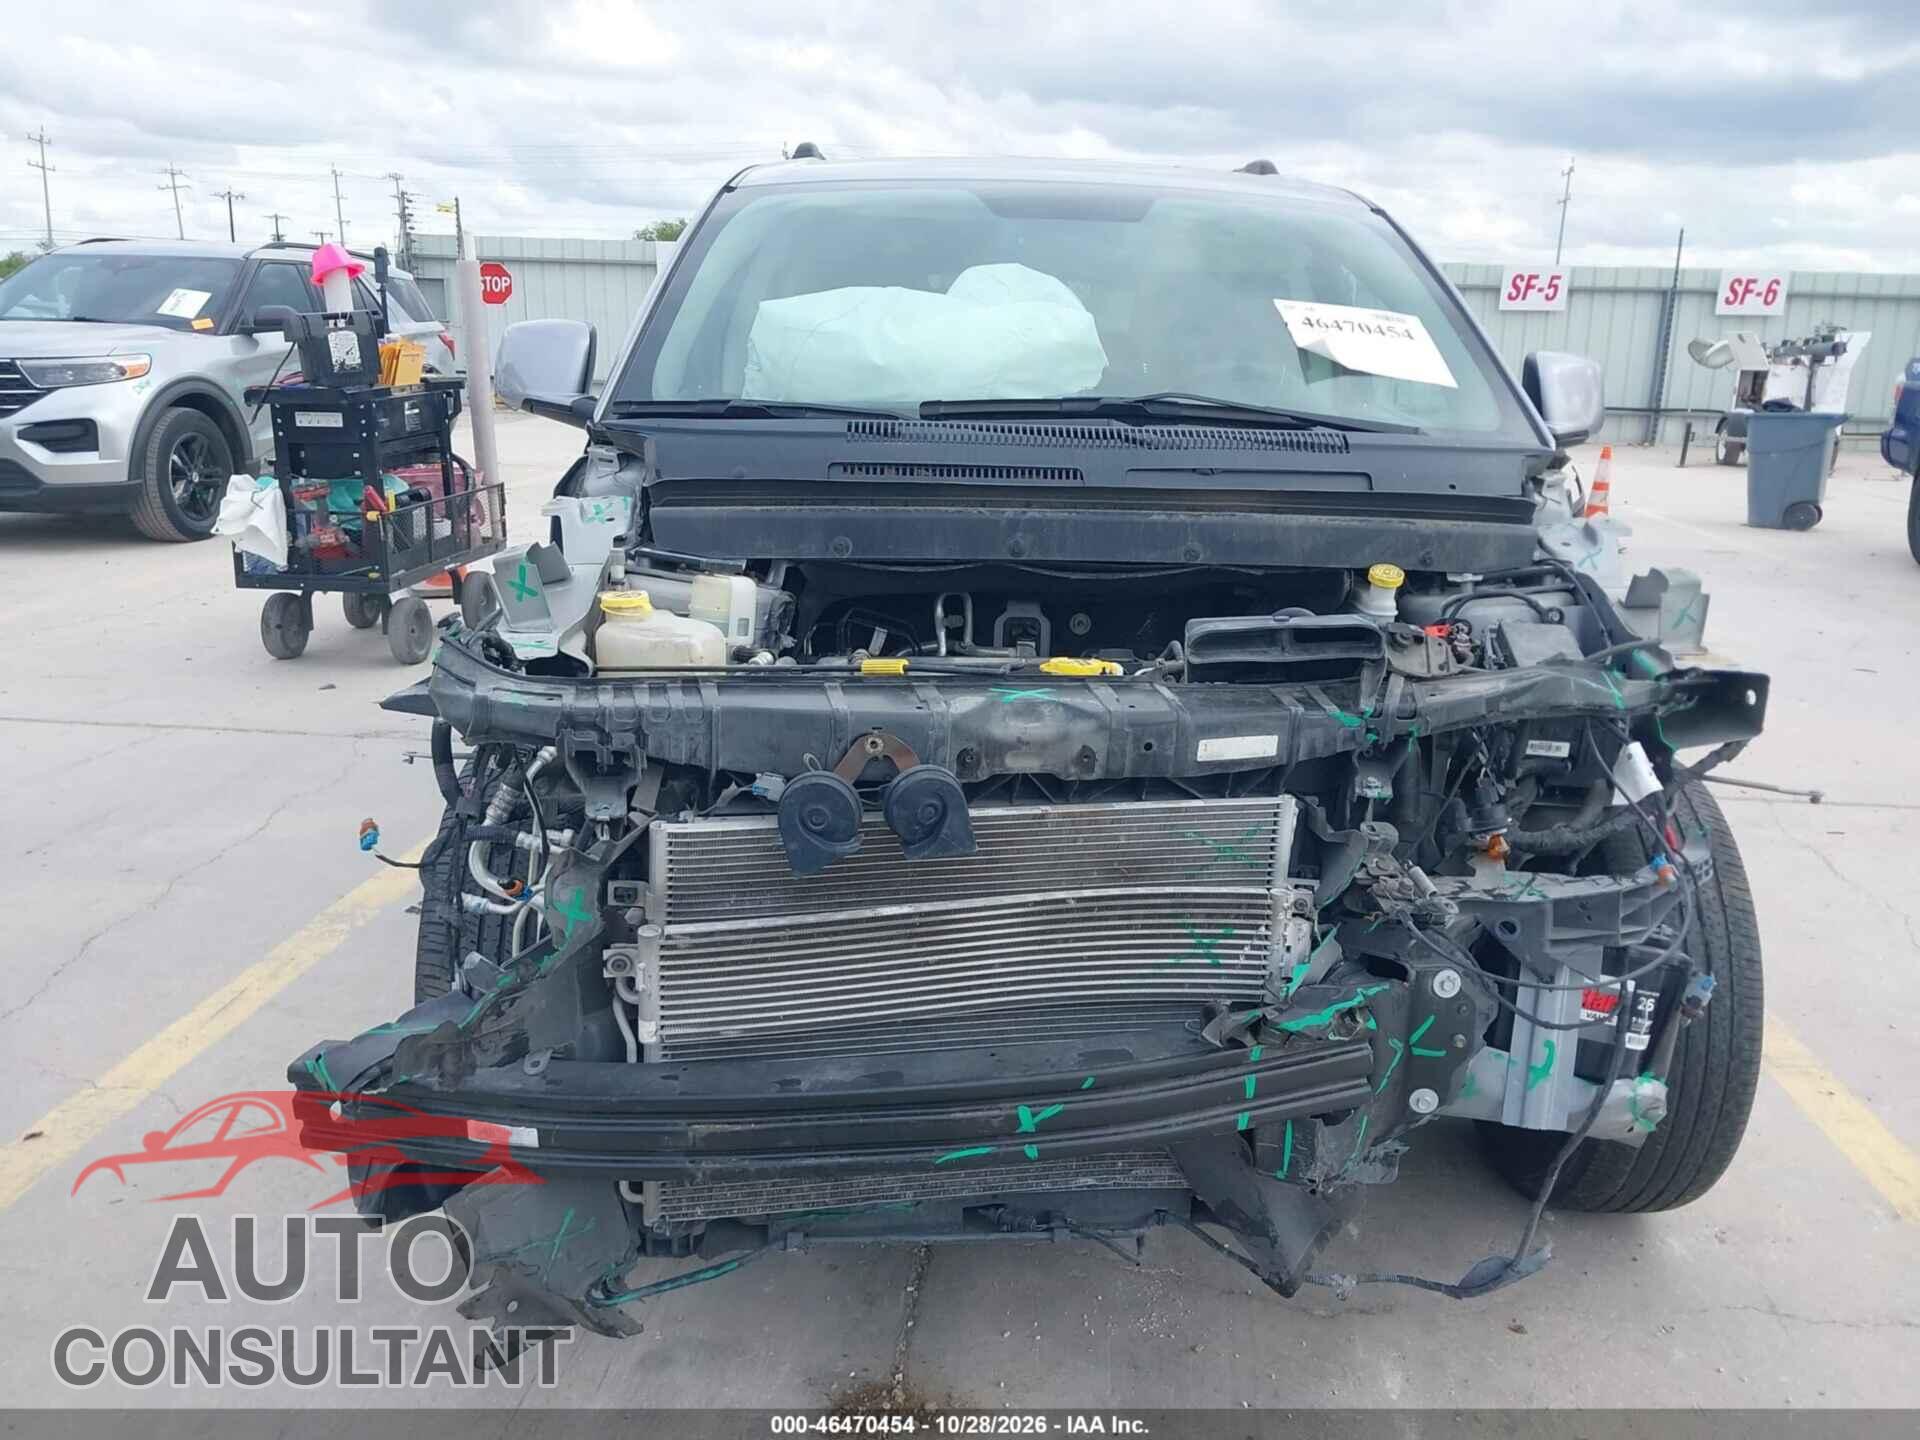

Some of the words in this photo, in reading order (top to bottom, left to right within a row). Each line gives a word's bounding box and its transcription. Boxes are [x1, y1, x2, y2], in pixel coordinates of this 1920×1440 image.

[1507, 273, 1562, 301] SF-5
[1725, 278, 1781, 306] SF-6
[1637, 996, 1656, 1012] 26
